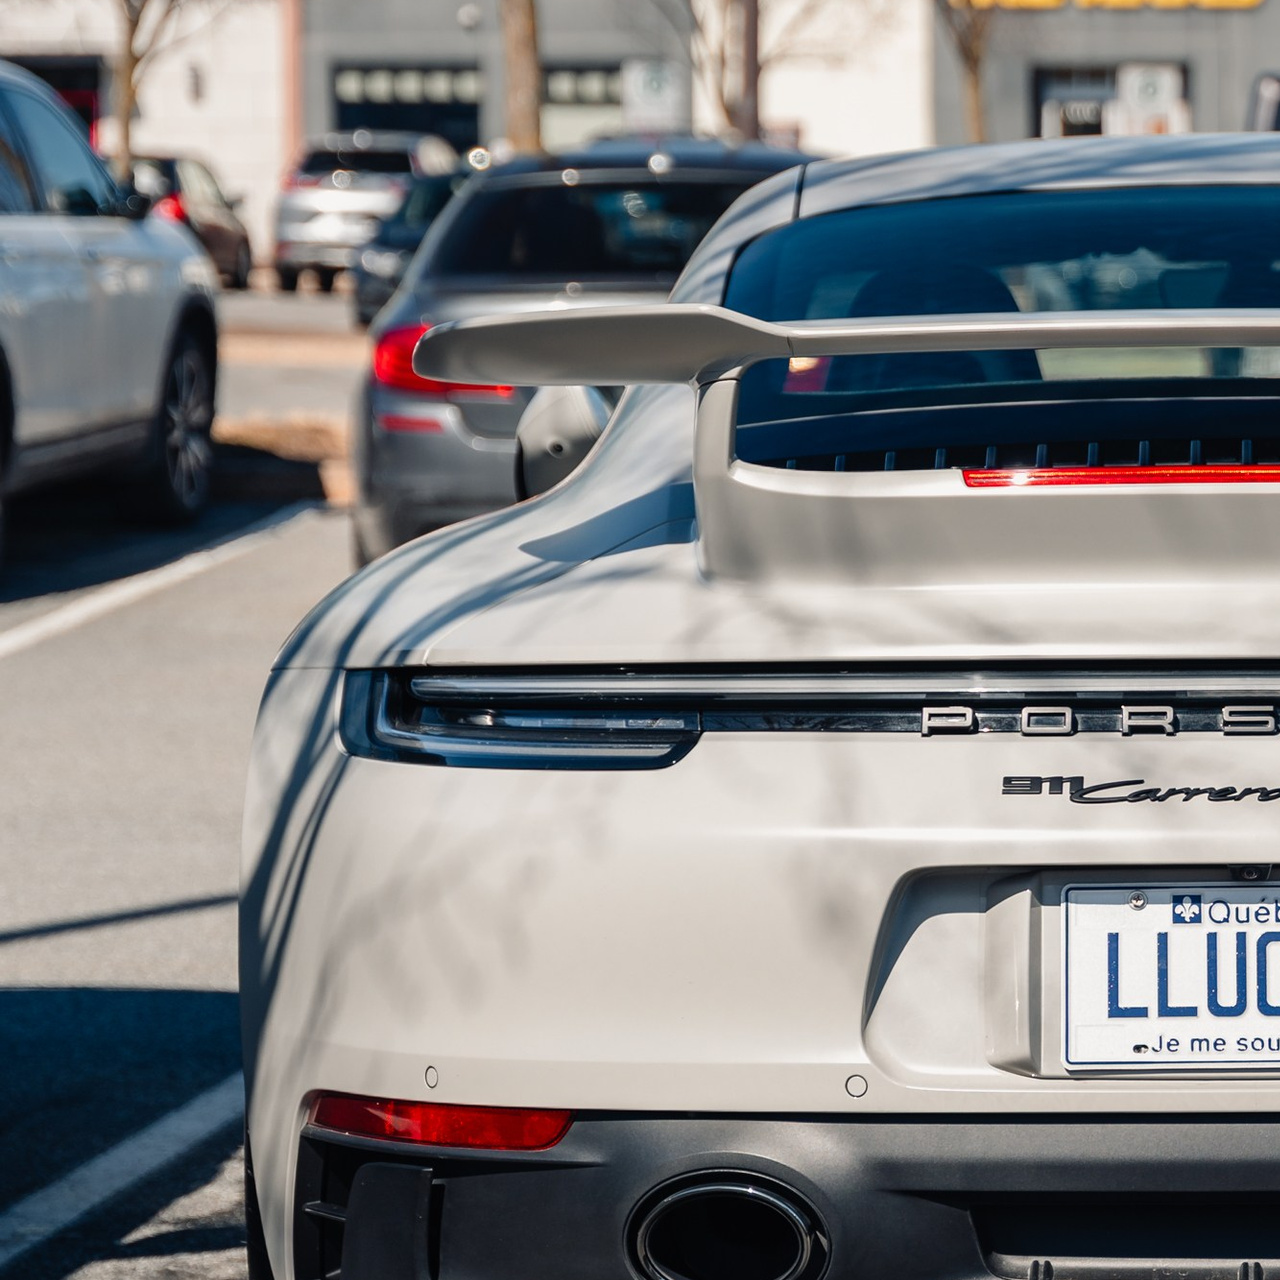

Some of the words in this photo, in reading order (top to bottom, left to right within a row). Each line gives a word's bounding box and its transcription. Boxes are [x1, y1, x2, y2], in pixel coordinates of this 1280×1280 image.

[1002, 776, 1084, 795] 911
[1151, 1034, 1180, 1053] Je
[1190, 1037, 1226, 1052] me
